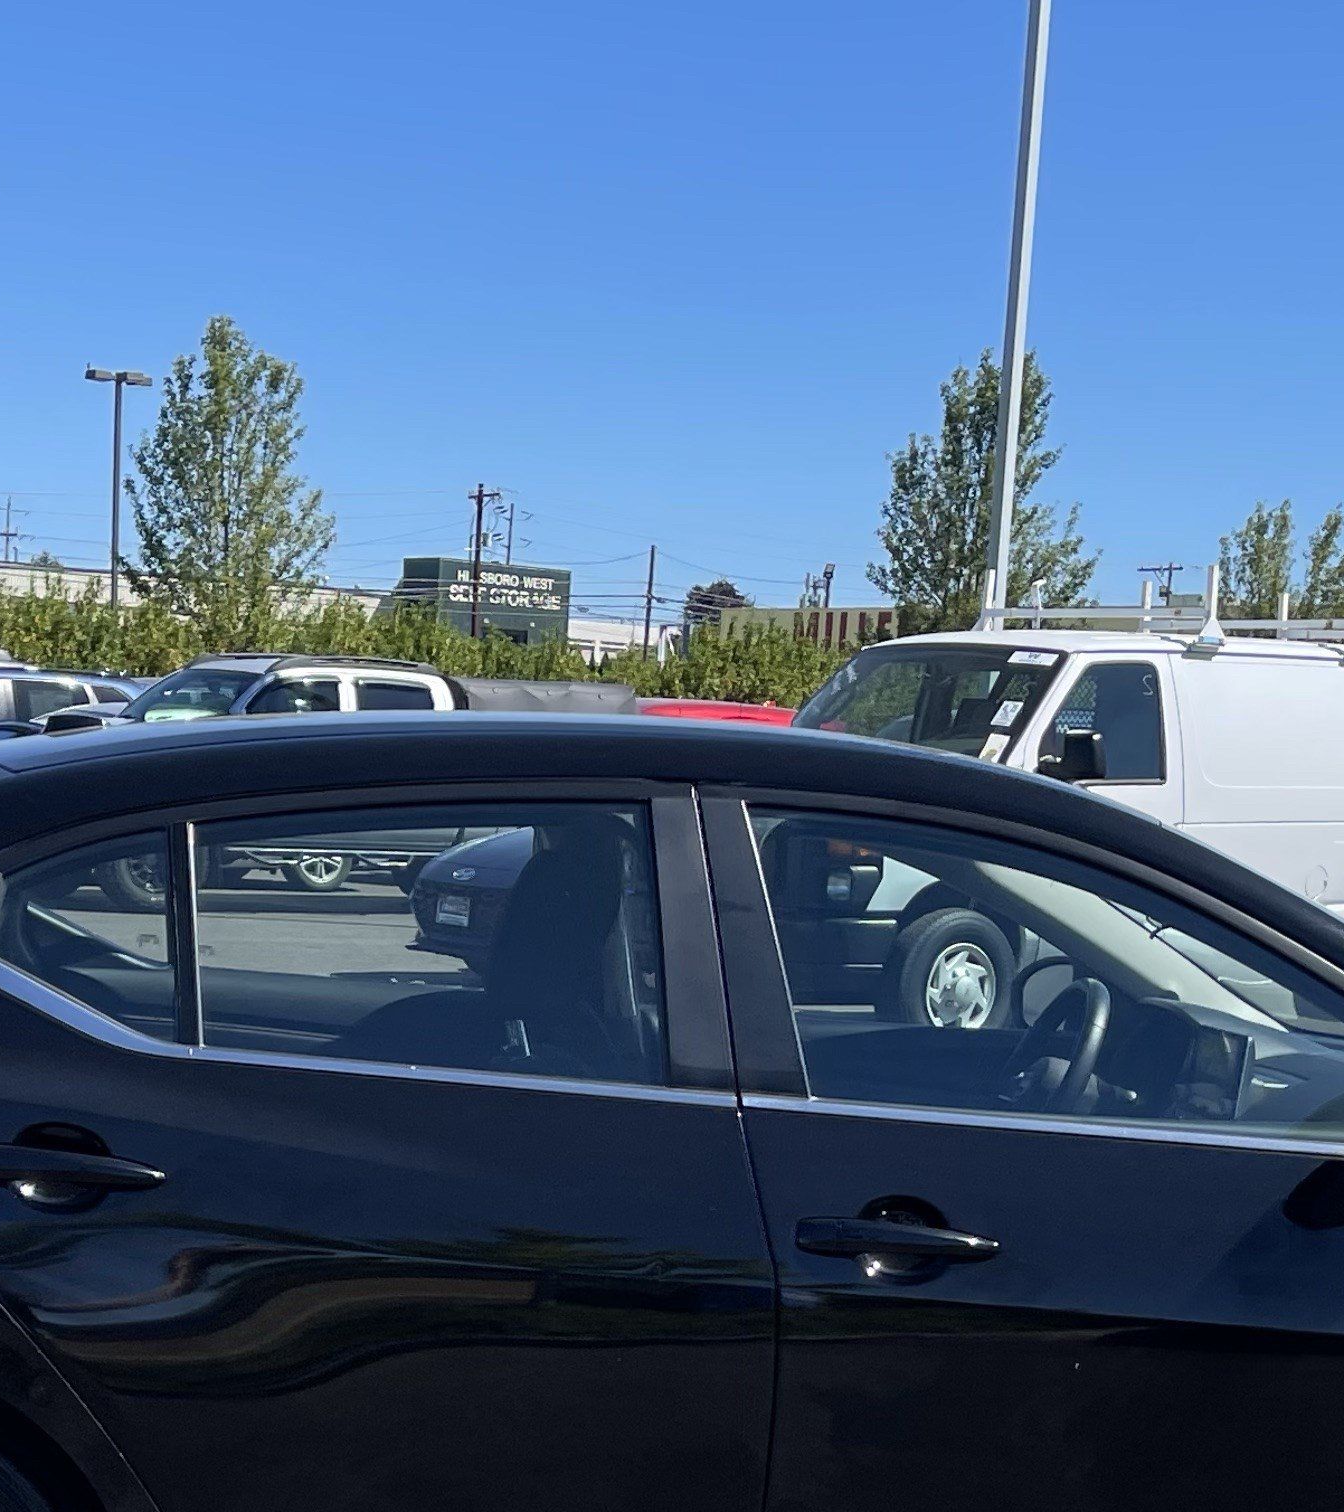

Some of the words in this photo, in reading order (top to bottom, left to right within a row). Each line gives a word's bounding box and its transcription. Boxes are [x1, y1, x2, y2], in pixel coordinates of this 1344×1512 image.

[457, 569, 519, 587] HISBORO
[523, 576, 555, 590] WEST
[489, 587, 562, 610] STORAGE
